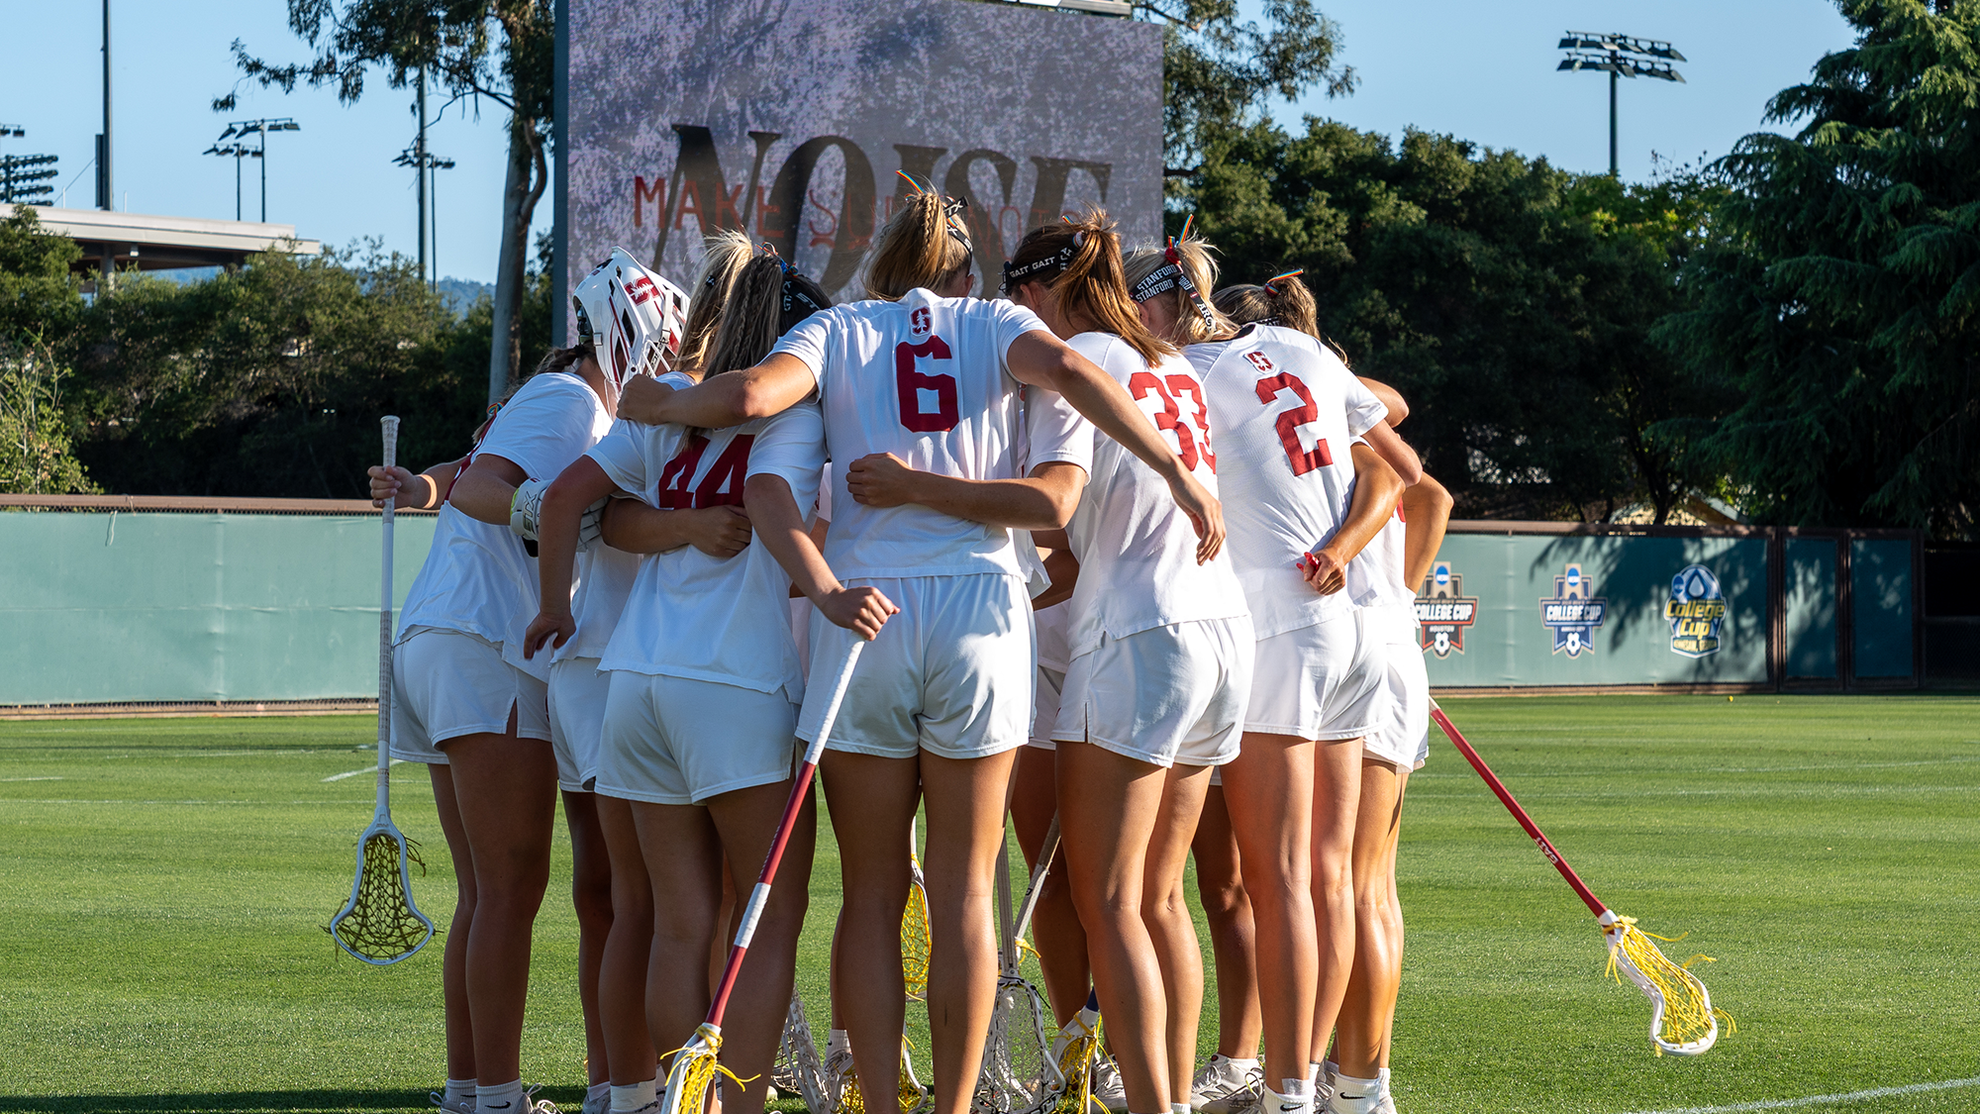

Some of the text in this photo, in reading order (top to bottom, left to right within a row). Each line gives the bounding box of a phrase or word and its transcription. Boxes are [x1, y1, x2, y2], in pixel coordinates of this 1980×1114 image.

[632, 175, 786, 238] MAKE
[807, 189, 898, 247] SU
[1032, 256, 1056, 270] GAIT
[1135, 278, 1175, 304] STANFORD
[1136, 263, 1178, 292] STANFORD
[895, 334, 960, 434] 6
[1128, 371, 1217, 475] 33
[1255, 371, 1334, 477] 2
[658, 431, 757, 510] 44
[1453, 603, 1473, 621] CUP
[1546, 605, 1602, 621] COLLEGE CUP
[1665, 600, 1726, 621] College
[1680, 617, 1711, 640] Cup
